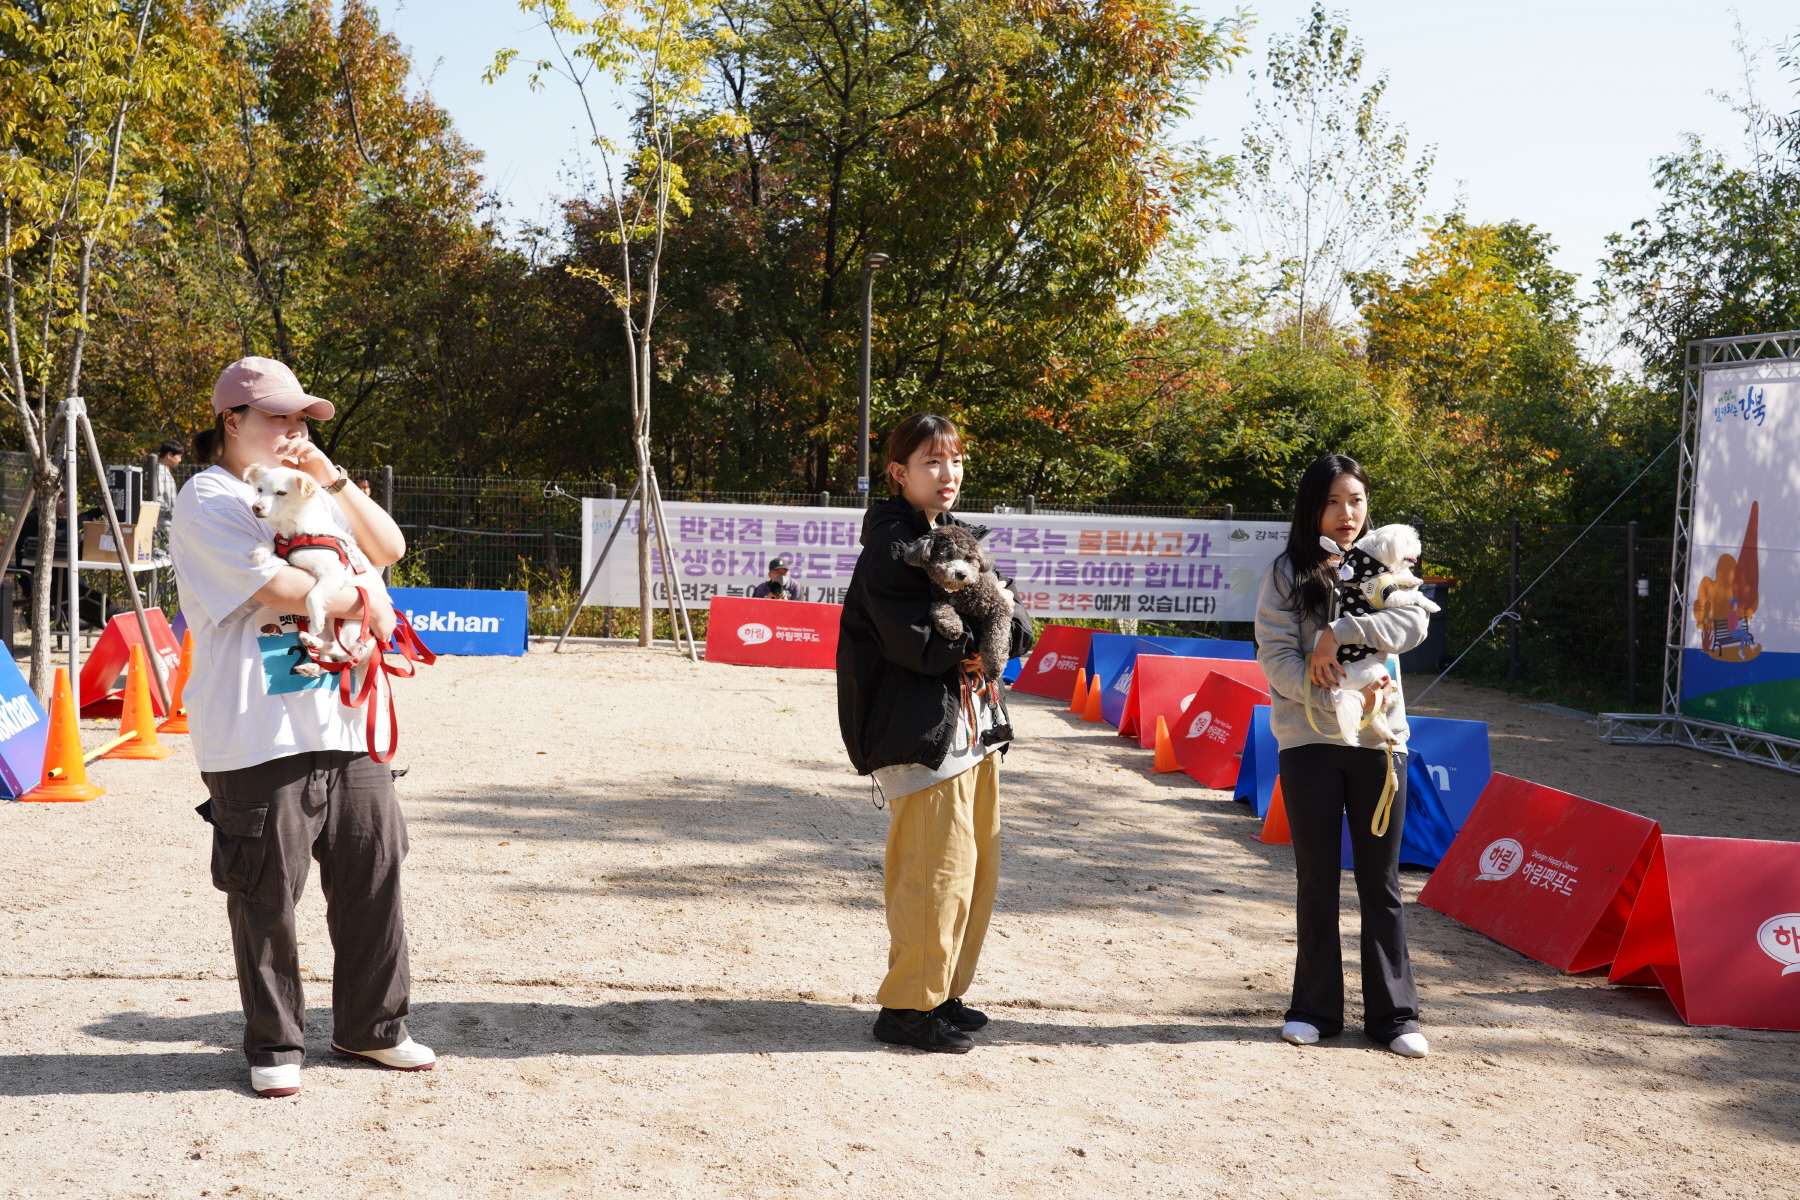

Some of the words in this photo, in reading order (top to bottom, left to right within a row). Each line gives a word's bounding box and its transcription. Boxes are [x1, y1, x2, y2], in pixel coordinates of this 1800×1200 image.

[1738, 386, 1766, 426] 강북
[680, 516, 763, 545] 반려견
[775, 519, 856, 548] 놀이터
[988, 527, 1068, 555] 견주는
[1078, 530, 1212, 558] 물림사고가
[652, 548, 766, 578] 발생하지
[779, 551, 860, 579] 않도록
[1029, 560, 1135, 587] 기울여야
[1145, 562, 1231, 589] 합니다.
[1057, 593, 1131, 612] 견주에게
[1137, 594, 1216, 614] 있습니다)
[405, 610, 499, 633] iskhan
[744, 628, 765, 639] 하림
[776, 631, 820, 642] 하림펫푸드
[1489, 845, 1517, 873] 하림
[1531, 850, 1548, 862] Design
[1547, 855, 1564, 868] Happy
[1562, 861, 1579, 873] Dance
[1522, 861, 1578, 896] 하림펫푸드
